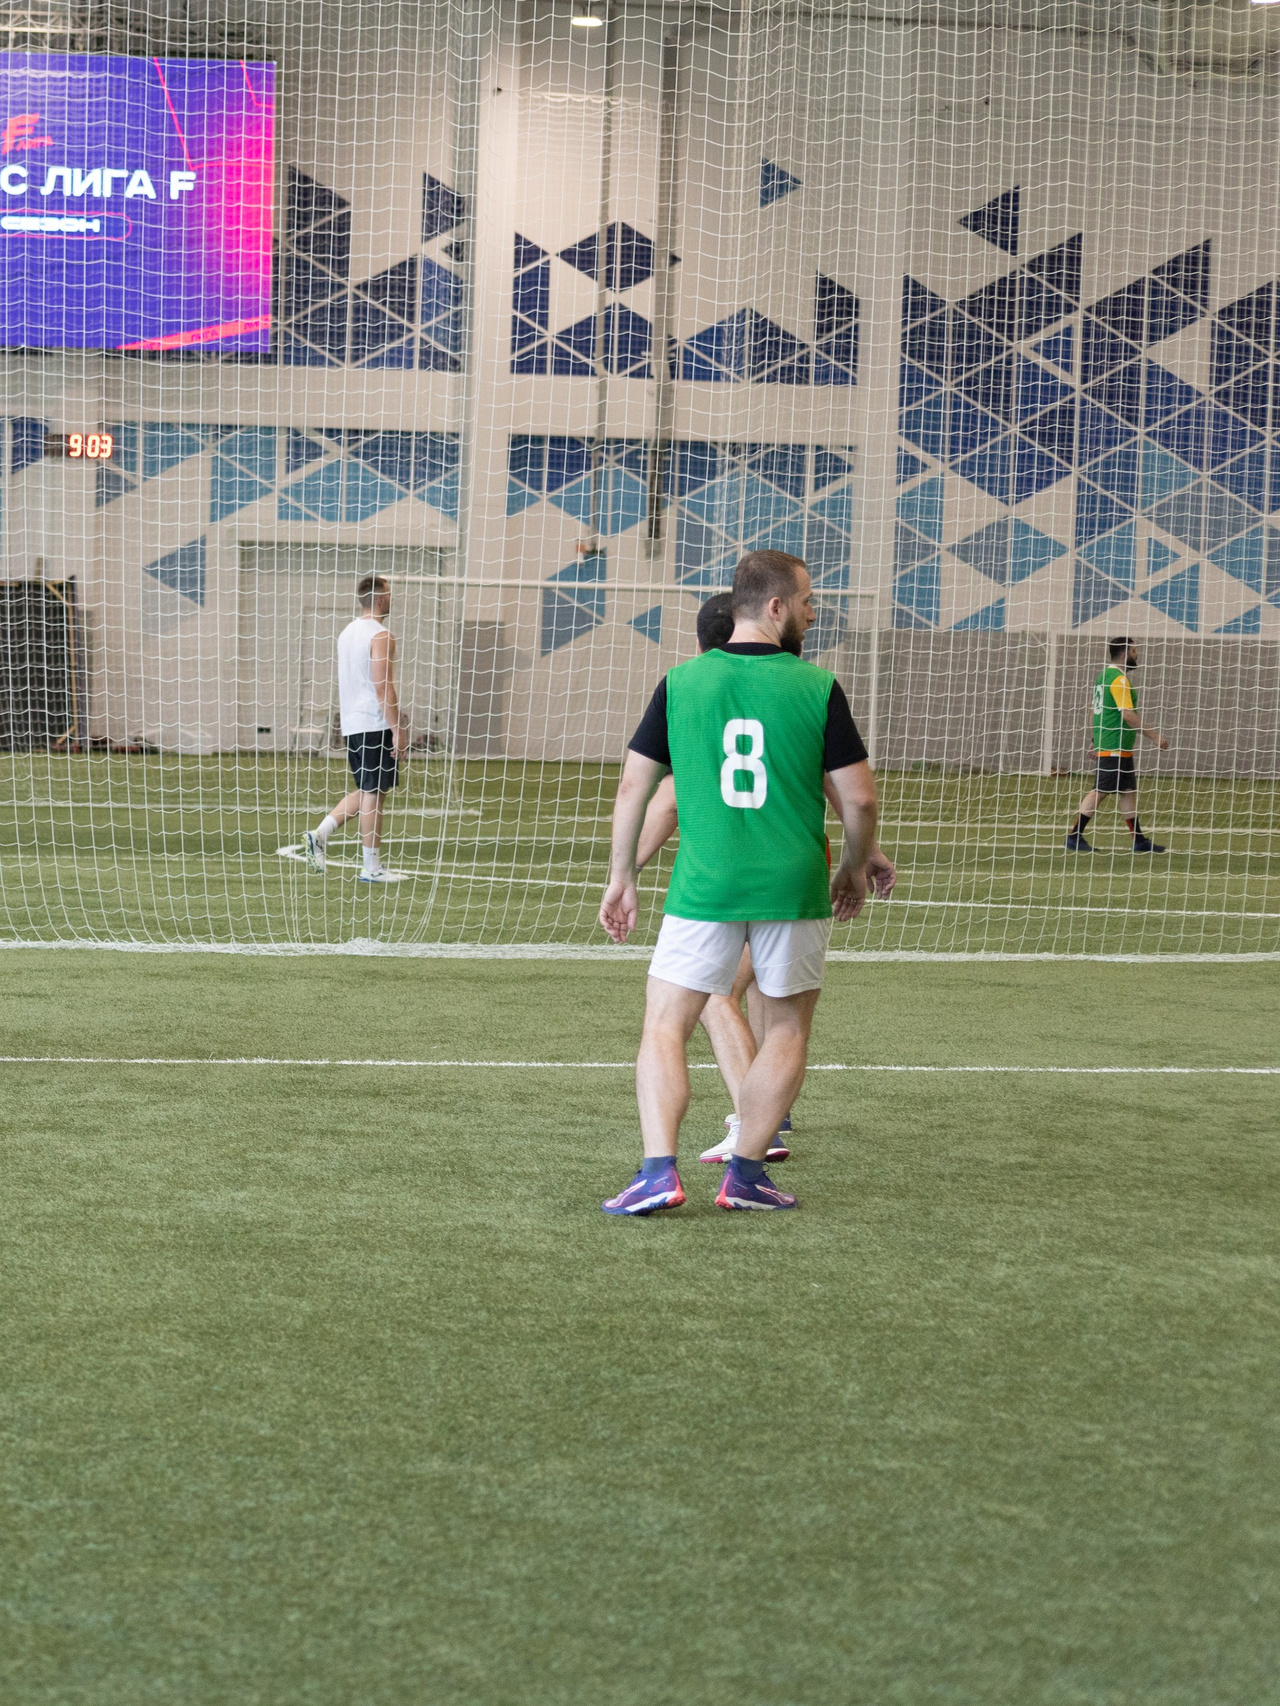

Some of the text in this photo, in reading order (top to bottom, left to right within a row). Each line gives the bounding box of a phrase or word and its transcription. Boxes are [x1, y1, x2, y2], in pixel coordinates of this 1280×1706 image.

[40, 166, 158, 199] ЛИГА
[169, 170, 197, 200] F
[720, 718, 767, 809] 8
